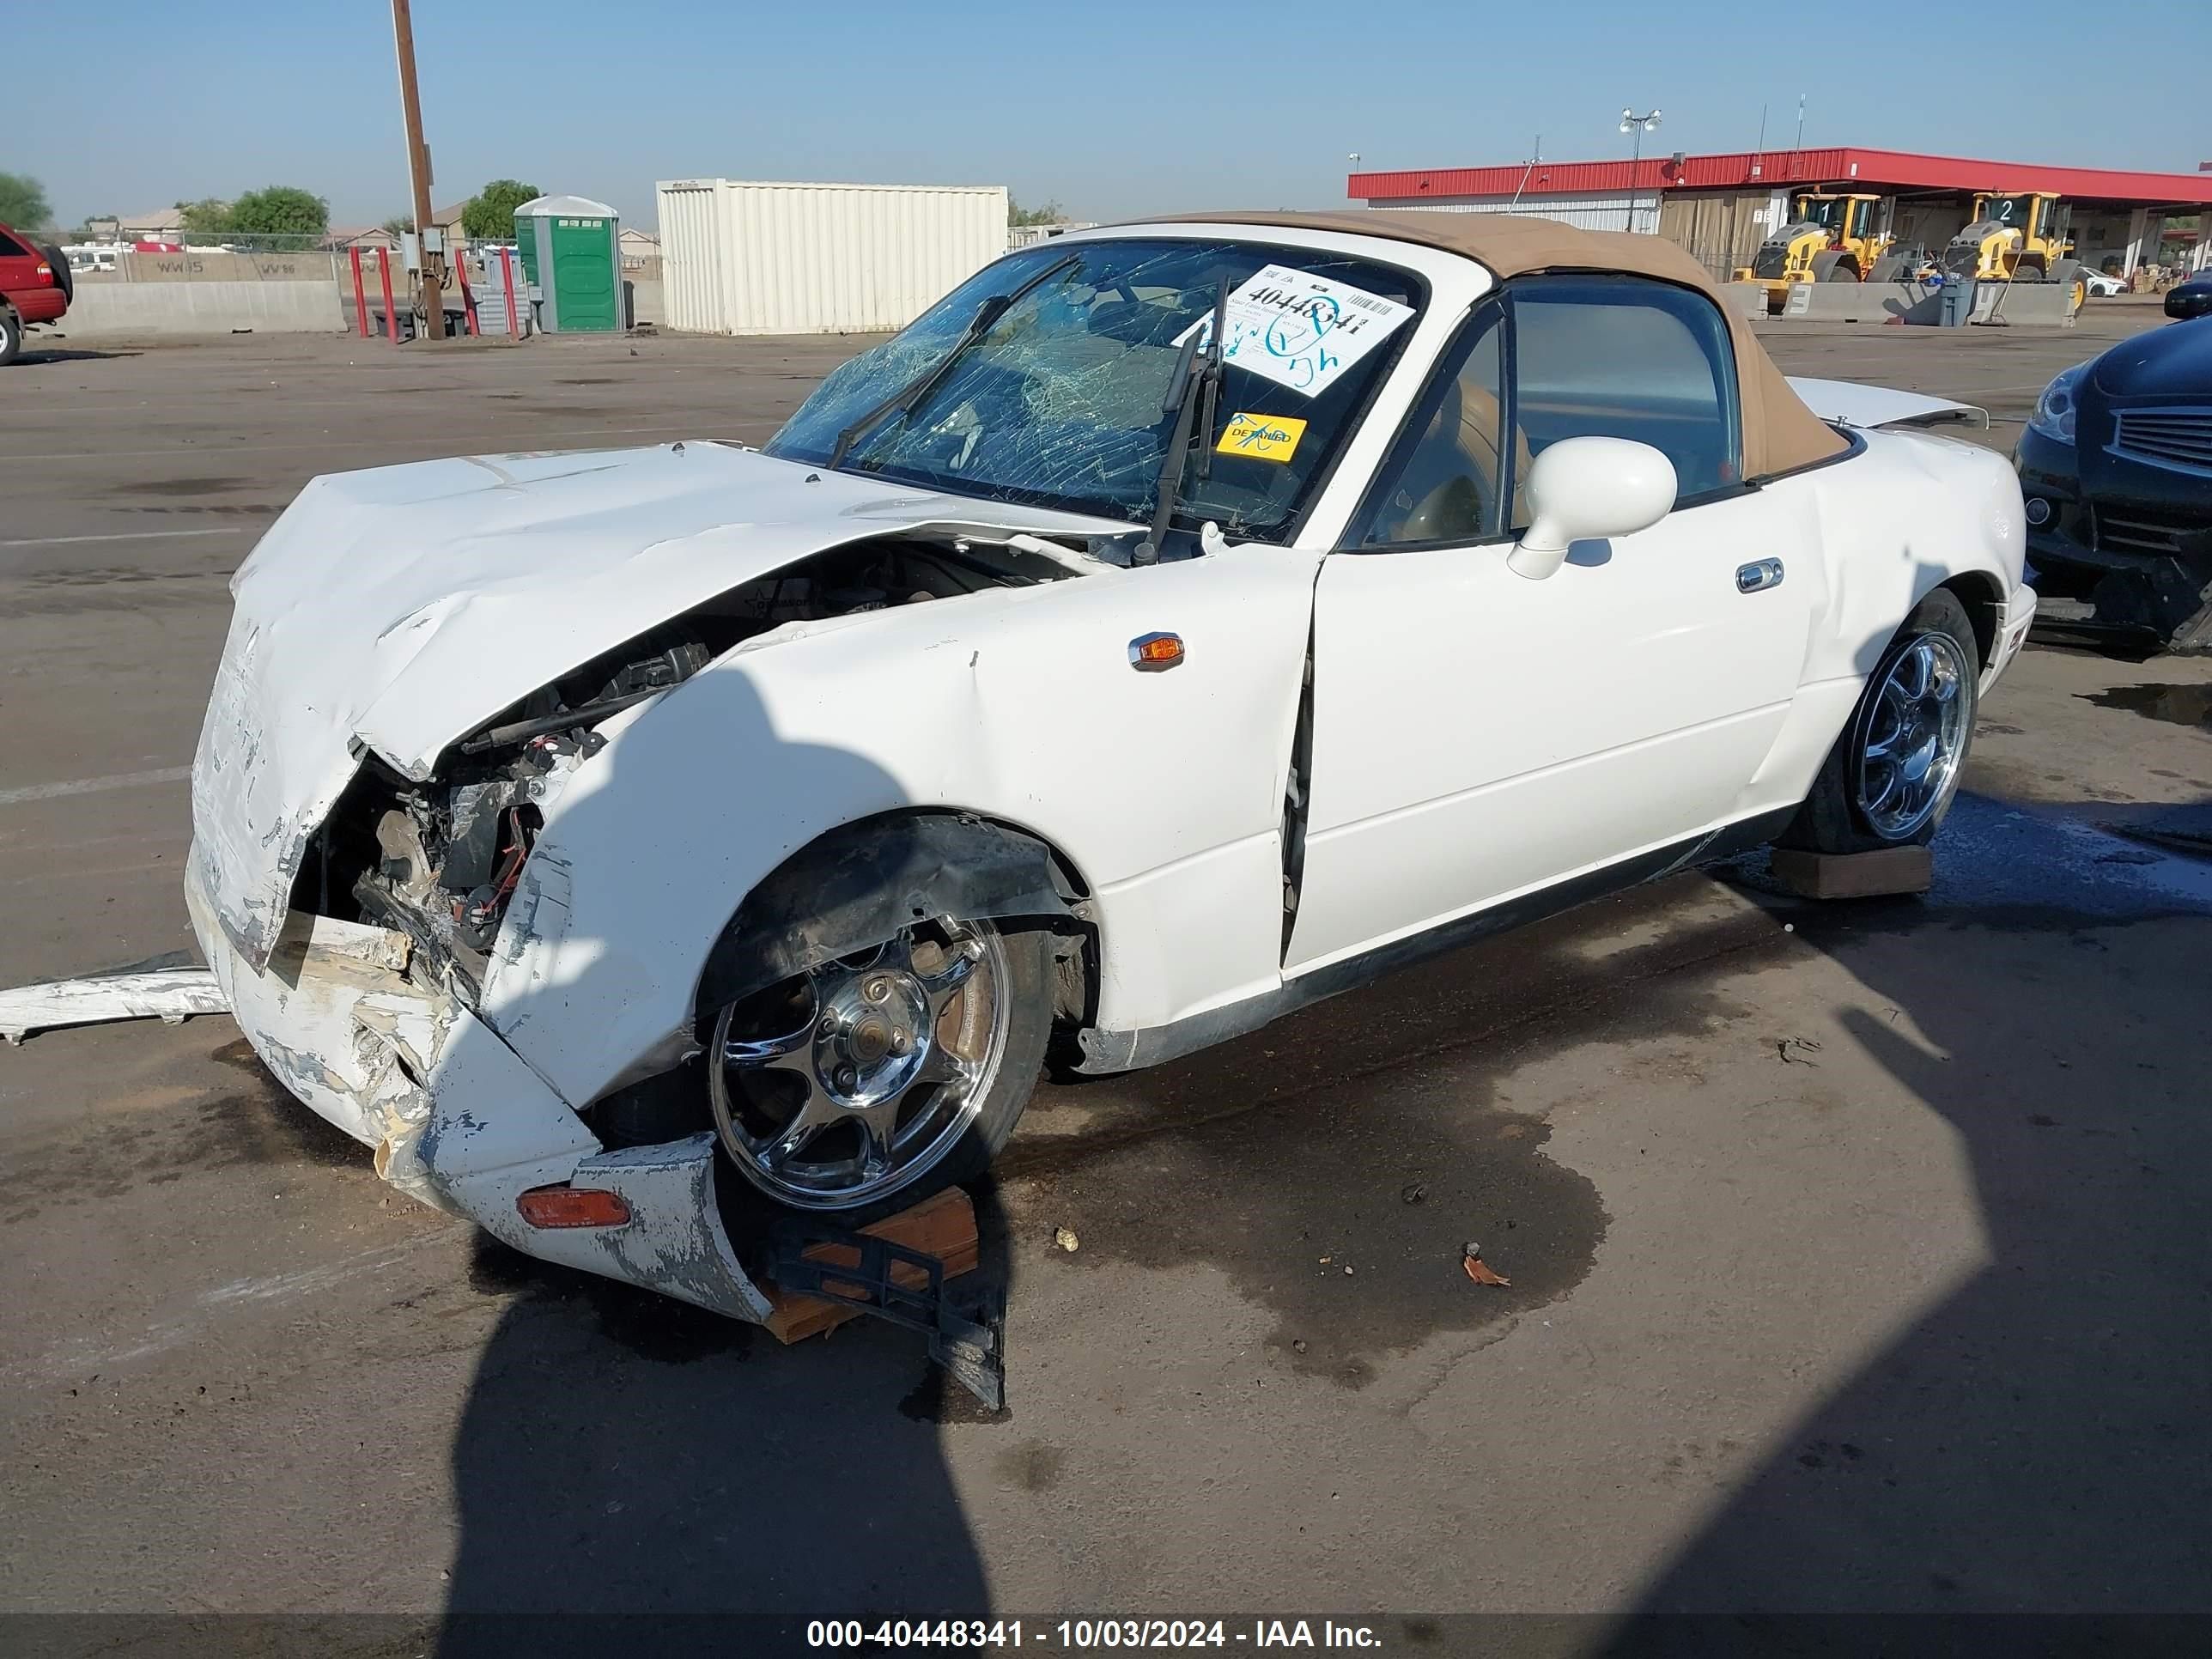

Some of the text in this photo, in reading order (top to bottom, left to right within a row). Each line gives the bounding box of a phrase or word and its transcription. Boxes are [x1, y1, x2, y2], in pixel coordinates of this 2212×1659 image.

[1821, 204, 1830, 222] 1
[2000, 200, 2013, 221] 2
[1790, 284, 1812, 314] 3
[1975, 286, 1996, 321] 4
